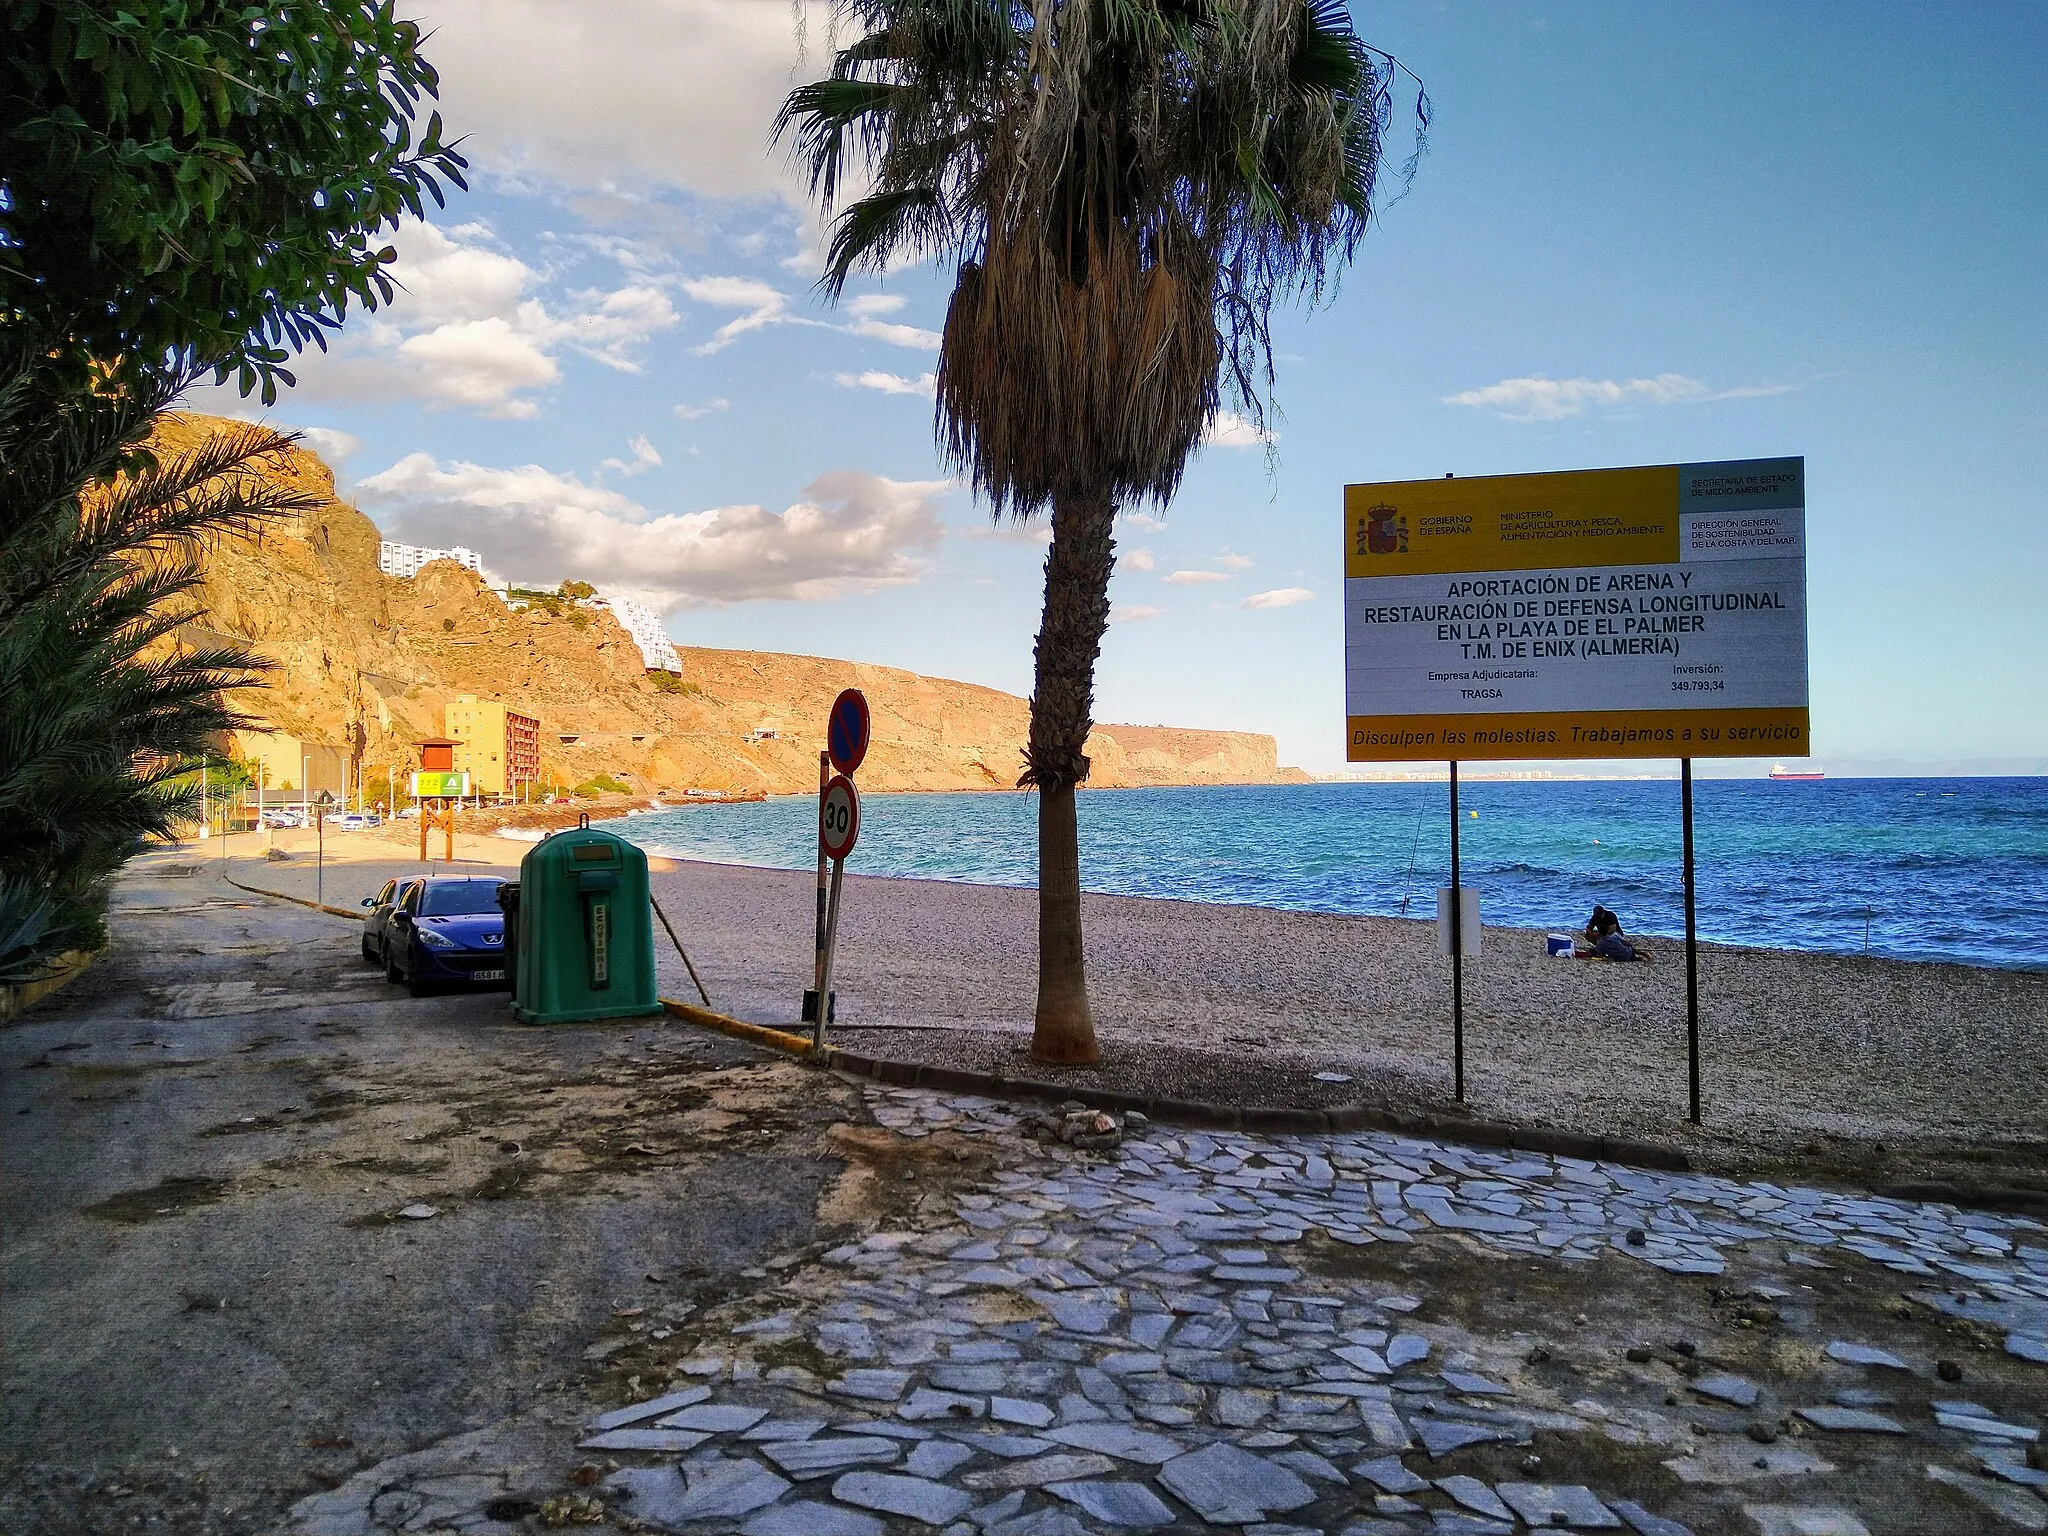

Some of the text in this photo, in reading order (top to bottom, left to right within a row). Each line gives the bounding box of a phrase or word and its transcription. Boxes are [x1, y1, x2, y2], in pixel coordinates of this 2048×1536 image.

[1746, 476, 1758, 484] DE
[1760, 473, 1796, 483] ESTADO
[1692, 484, 1779, 496] DE MEDIO AMBIENTE
[1419, 515, 1473, 526] GOBIERNO
[1500, 510, 1554, 520] MINISTERIO
[1420, 524, 1473, 535] DE ESPAÑA
[1500, 523, 1513, 531] DE
[1514, 519, 1582, 530] AGRICULTURA
[1582, 518, 1589, 527] Y
[1691, 518, 1782, 530] DIRECCIÓN GENERAL
[1573, 529, 1580, 537] Y
[1582, 527, 1615, 537] MEDIO
[1616, 525, 1665, 535] AMBIENTE
[1692, 528, 1776, 539] DE SOSTENIBILIDAD
[1692, 541, 1703, 549] DE
[1705, 540, 1717, 548] LA
[1718, 538, 1747, 547] COSTA
[1748, 538, 1755, 546] Y
[1757, 537, 1774, 546] DEL
[1447, 571, 1693, 598] APORTACIÓN DE ARENA Y
[1364, 592, 1786, 624] RESTAURACIÓN DE DEFENSA LONGITUDINAL
[1437, 615, 1706, 640] EN LA PLAYA DE EL PALMER
[1460, 633, 1680, 661] T.M. DE ENIX (ALMERÍA)
[1428, 668, 1538, 682] Empresa Adjudicataria:
[1672, 663, 1724, 675] Inversión:
[1671, 680, 1725, 691] 349.793,34
[1460, 689, 1503, 699] TRAGSA
[1353, 725, 1800, 748] Disculpen las molestias. Trabajamos a su servicio
[419, 779, 438, 787] 112
[815, 801, 849, 834] 30
